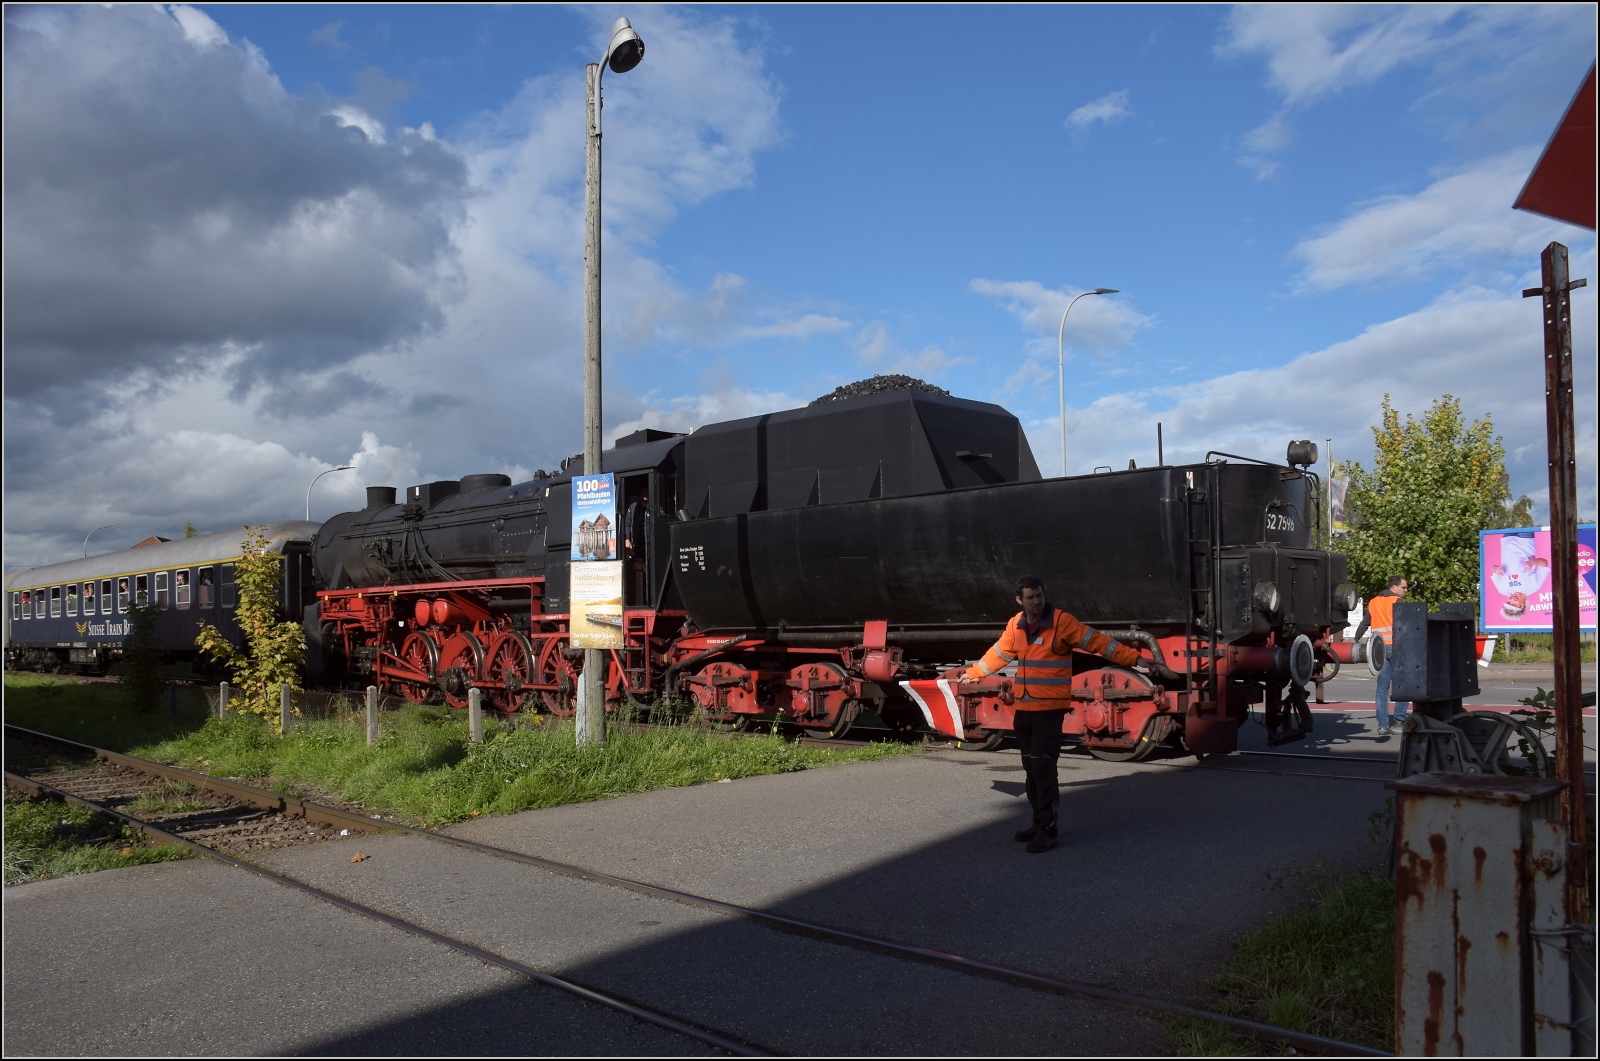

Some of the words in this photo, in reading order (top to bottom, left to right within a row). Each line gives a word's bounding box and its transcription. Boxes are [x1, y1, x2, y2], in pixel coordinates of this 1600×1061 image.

[576, 480, 598, 492] 100
[1278, 514, 1295, 531] 7596
[88, 620, 105, 636] SUISSE
[106, 619, 122, 635] TRAIN
